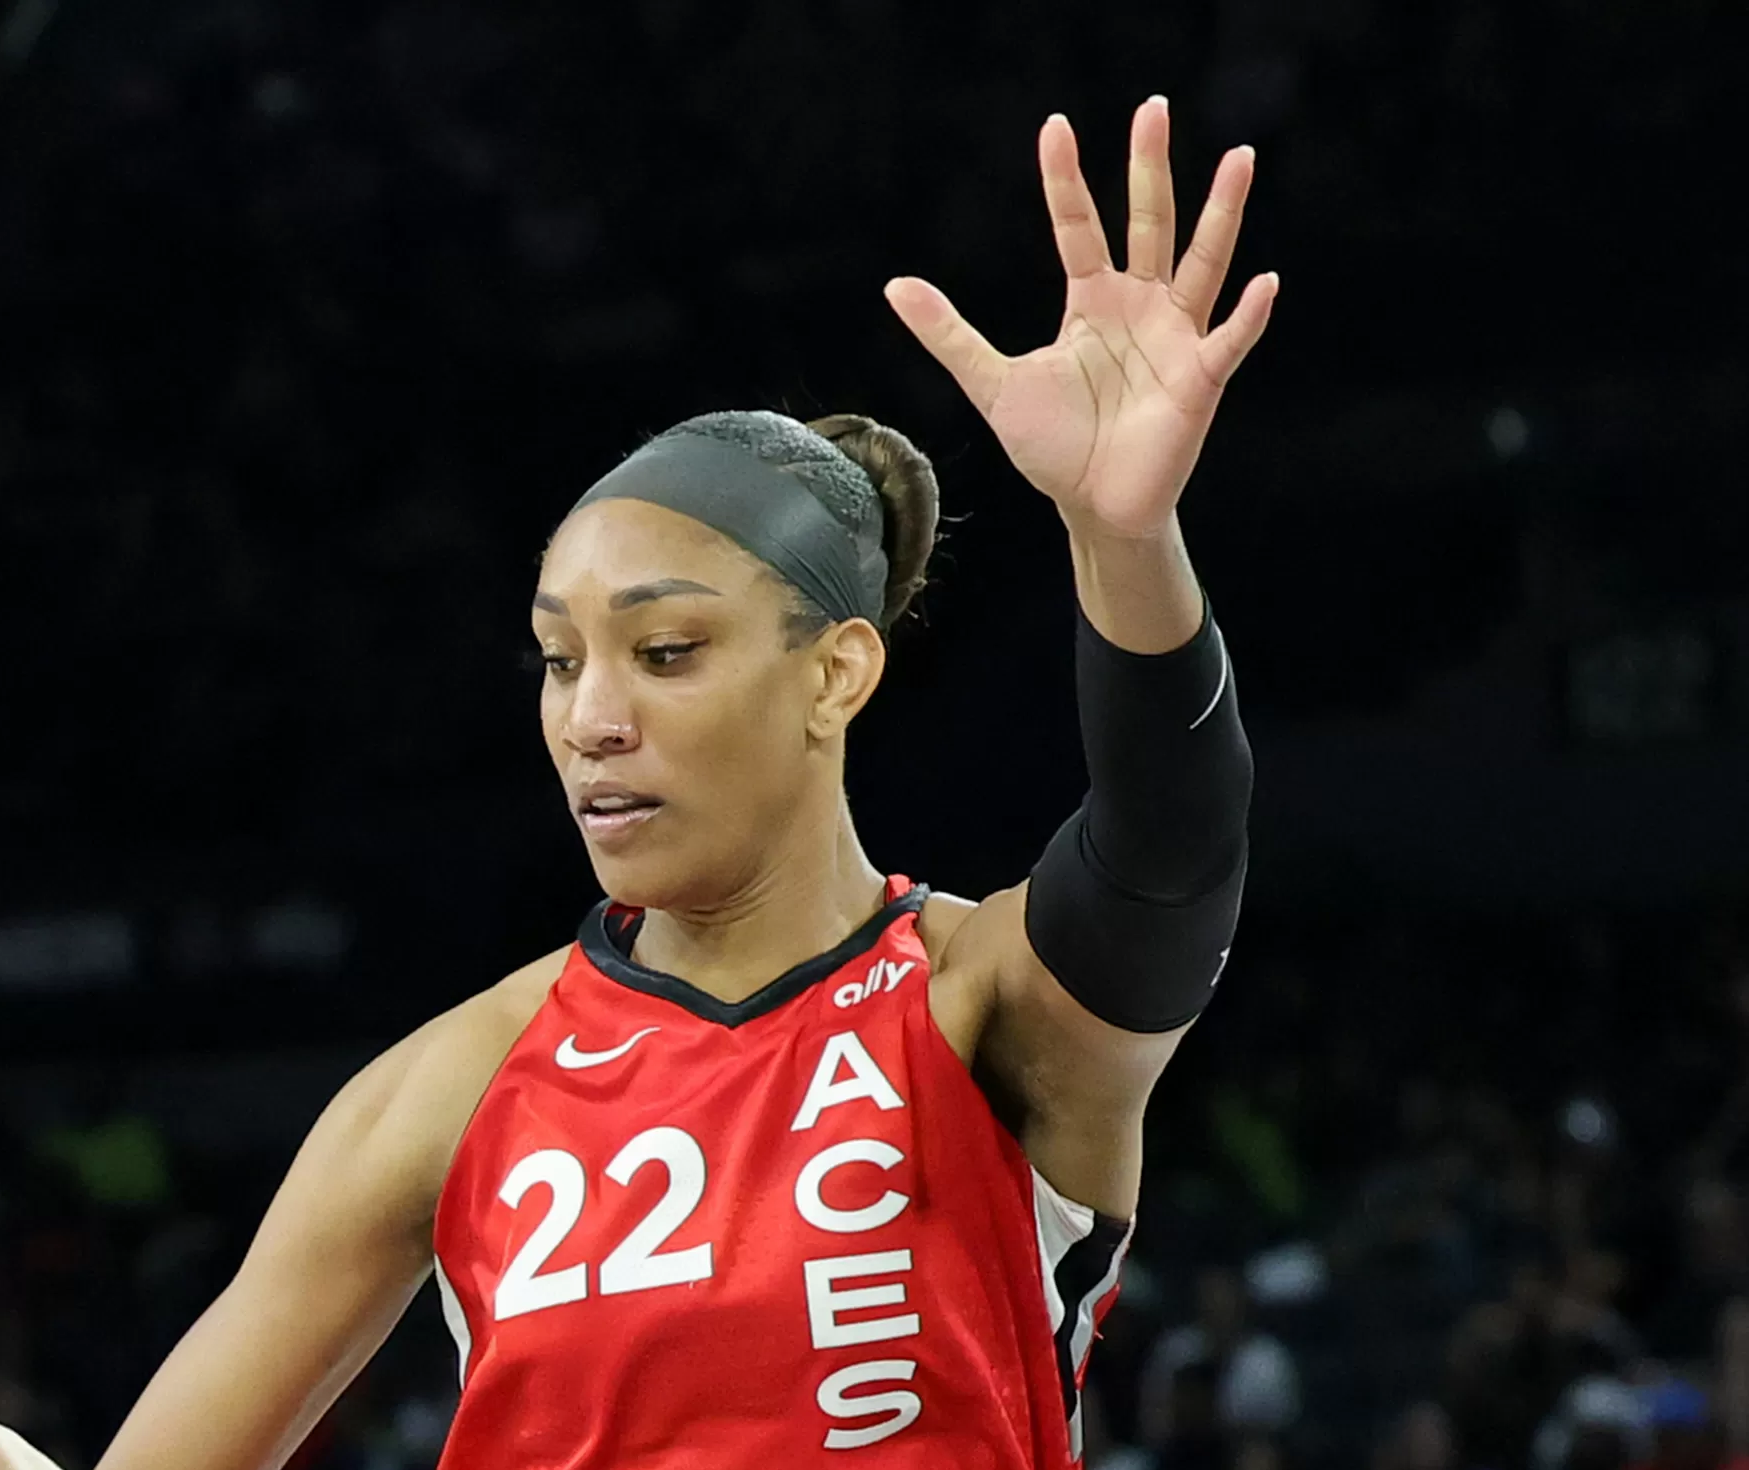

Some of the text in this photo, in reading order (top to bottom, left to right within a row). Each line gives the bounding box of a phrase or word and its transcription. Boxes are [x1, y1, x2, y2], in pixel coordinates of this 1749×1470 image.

[833, 957, 917, 1010] ally
[494, 1125, 714, 1322] 22
[790, 1030, 924, 1450] ACES
